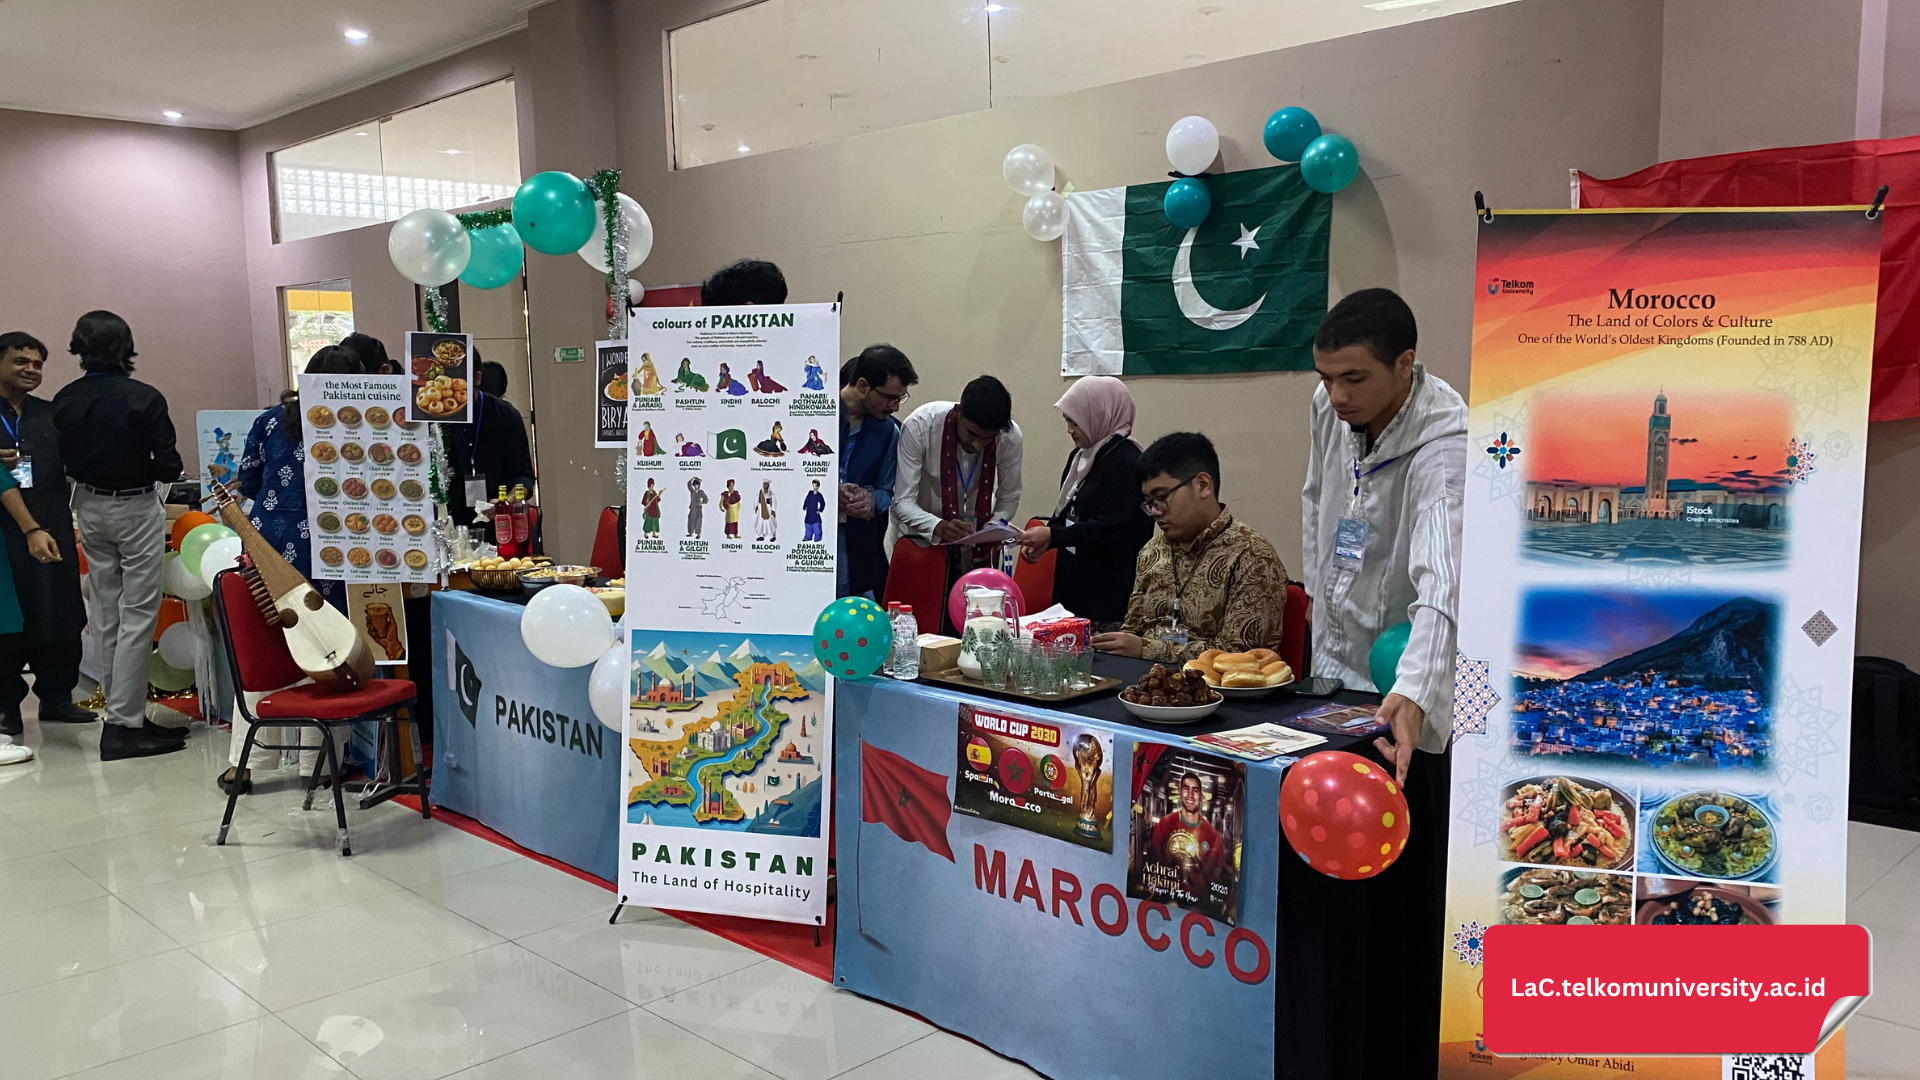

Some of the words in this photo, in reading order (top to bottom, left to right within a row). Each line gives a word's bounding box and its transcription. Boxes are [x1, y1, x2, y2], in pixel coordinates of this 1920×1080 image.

[1501, 280, 1534, 288] Telkom
[1608, 288, 1716, 310] Morocco
[652, 318, 692, 330] colours
[694, 317, 708, 328] of
[711, 313, 794, 329] PAKISTAN
[1568, 314, 1592, 327] The
[1597, 314, 1630, 327] Land
[1635, 314, 1650, 327] of
[1652, 314, 1698, 327] Colors
[1702, 315, 1714, 327] &
[1718, 315, 1773, 328] Culture
[1518, 334, 1539, 343] One
[1542, 333, 1553, 343] of
[1556, 334, 1572, 344] the
[1620, 334, 1654, 344] Oldest
[1658, 335, 1714, 347] Kingdoms
[1717, 335, 1770, 347] (Founded
[1774, 336, 1784, 345] in
[1788, 336, 1807, 346] 788
[1810, 336, 1834, 347] AD)
[326, 381, 340, 389] the
[364, 382, 397, 390] Famous
[323, 391, 366, 400] Pakistani
[368, 392, 401, 401] cuisine
[1686, 506, 1713, 514] iStock
[363, 584, 388, 597] چائے
[495, 694, 603, 760] PAKISTAN
[974, 713, 1008, 733] WORLD
[1009, 721, 1029, 737] CUP
[1030, 726, 1057, 744] 2030
[632, 842, 813, 876] PAKISTAN
[1142, 861, 1180, 878] Achraf
[632, 871, 658, 884] The
[664, 874, 698, 888] Land
[704, 878, 719, 890] of
[725, 880, 811, 901] Hospitality
[1142, 874, 1180, 890] Hakimi
[1211, 882, 1228, 895] 2025
[974, 843, 1271, 985] MAROCCO
[1468, 1052, 1492, 1060] Telkom
[1567, 1053, 1599, 1067] Omar
[1602, 1057, 1635, 1072] Abidi
